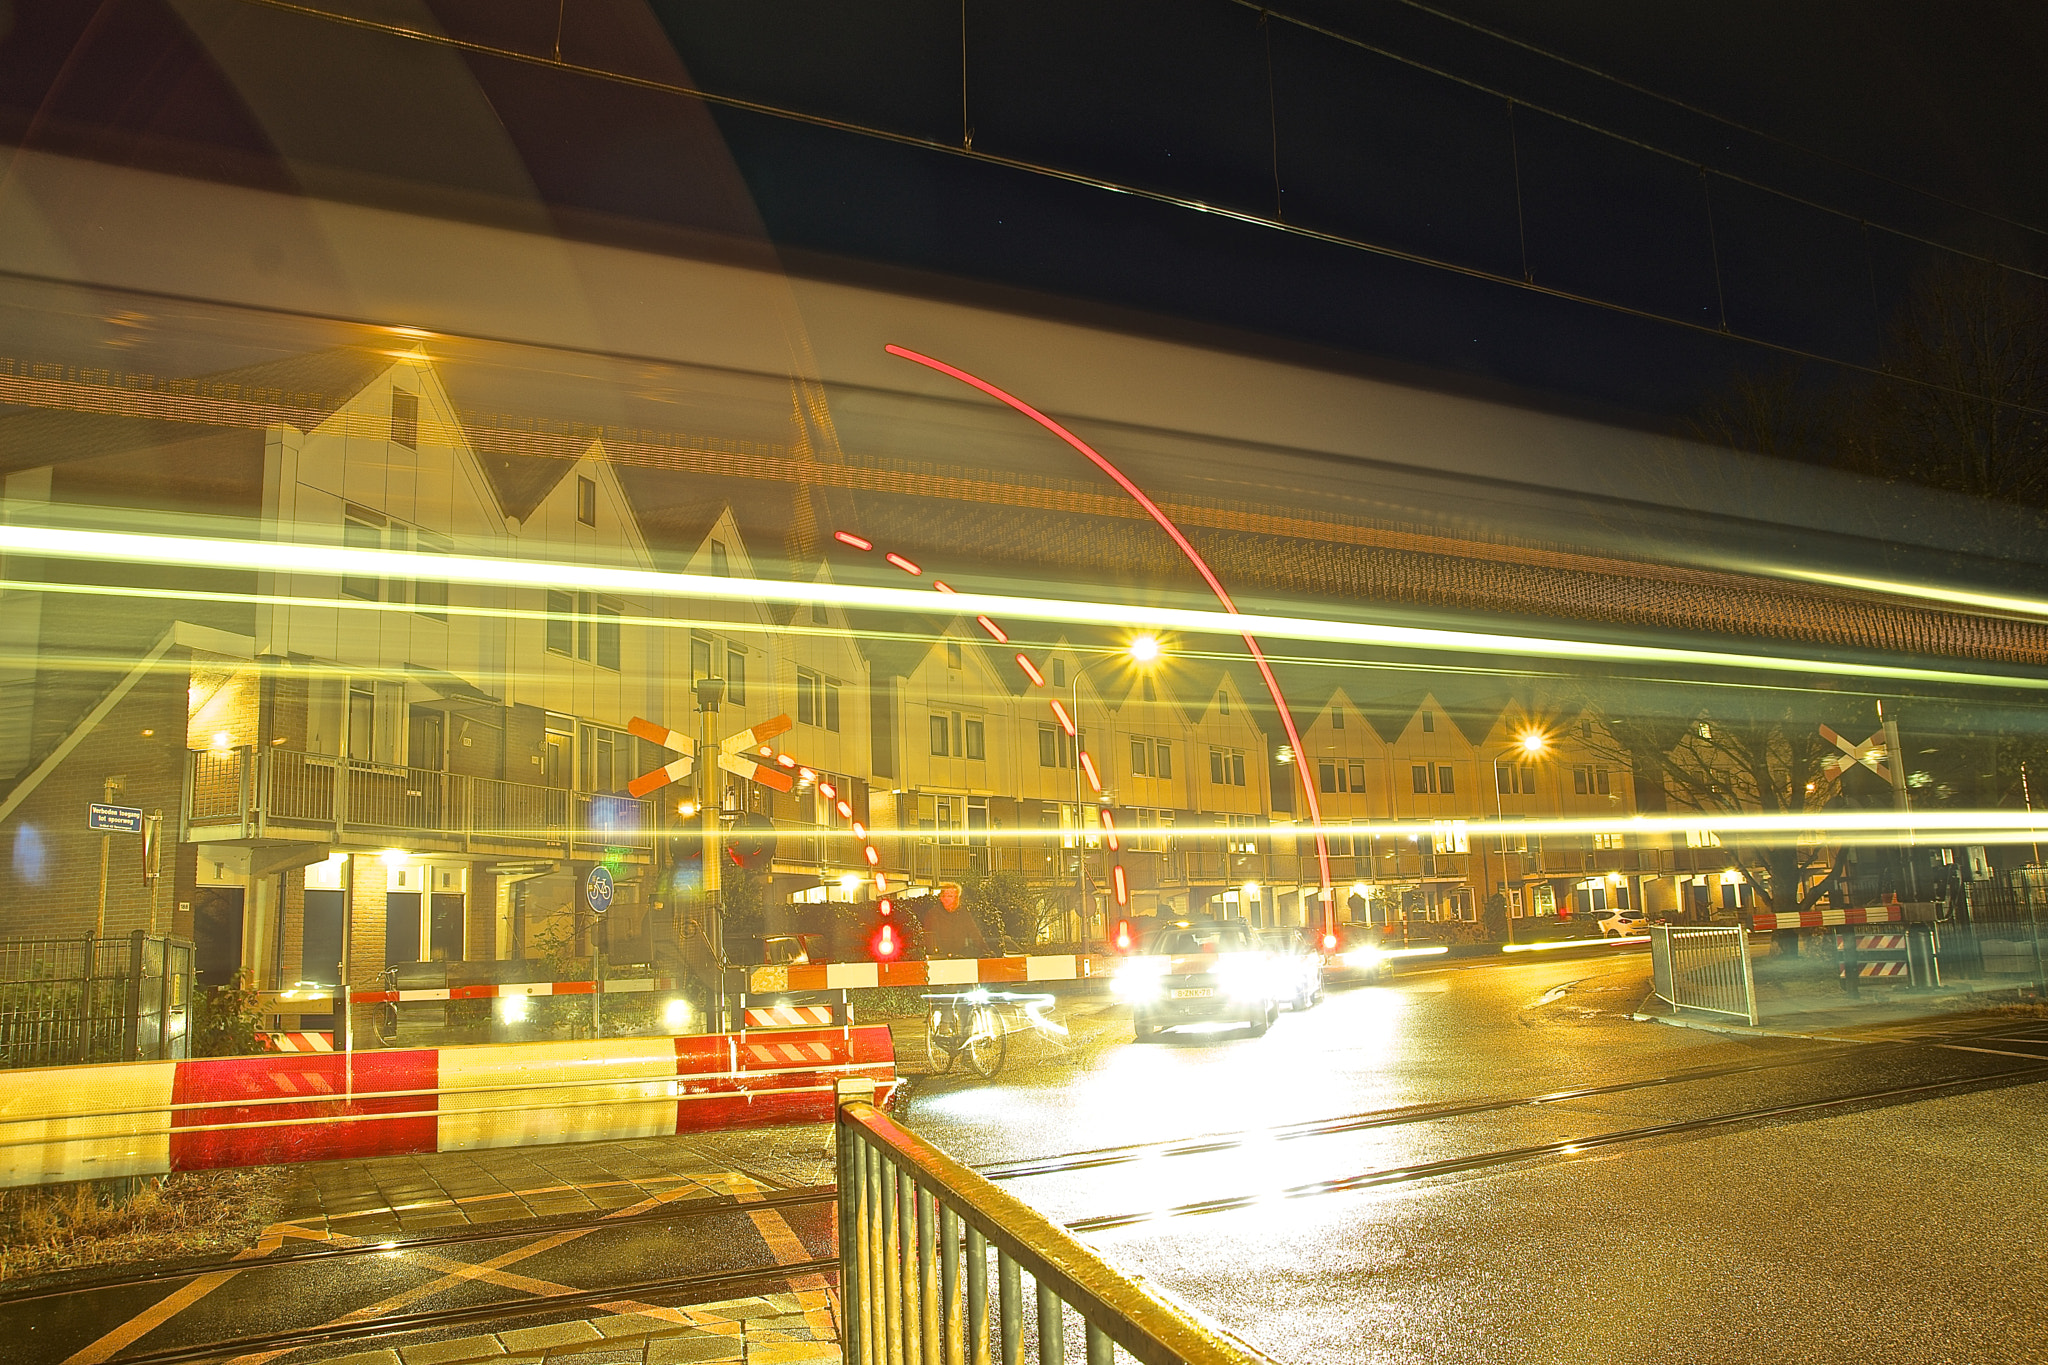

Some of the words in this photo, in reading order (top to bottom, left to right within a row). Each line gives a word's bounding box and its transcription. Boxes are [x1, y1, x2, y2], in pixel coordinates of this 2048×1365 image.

[92, 807, 117, 815] Verboden
[119, 810, 140, 819] toegang
[107, 817, 133, 825] spoorweg
